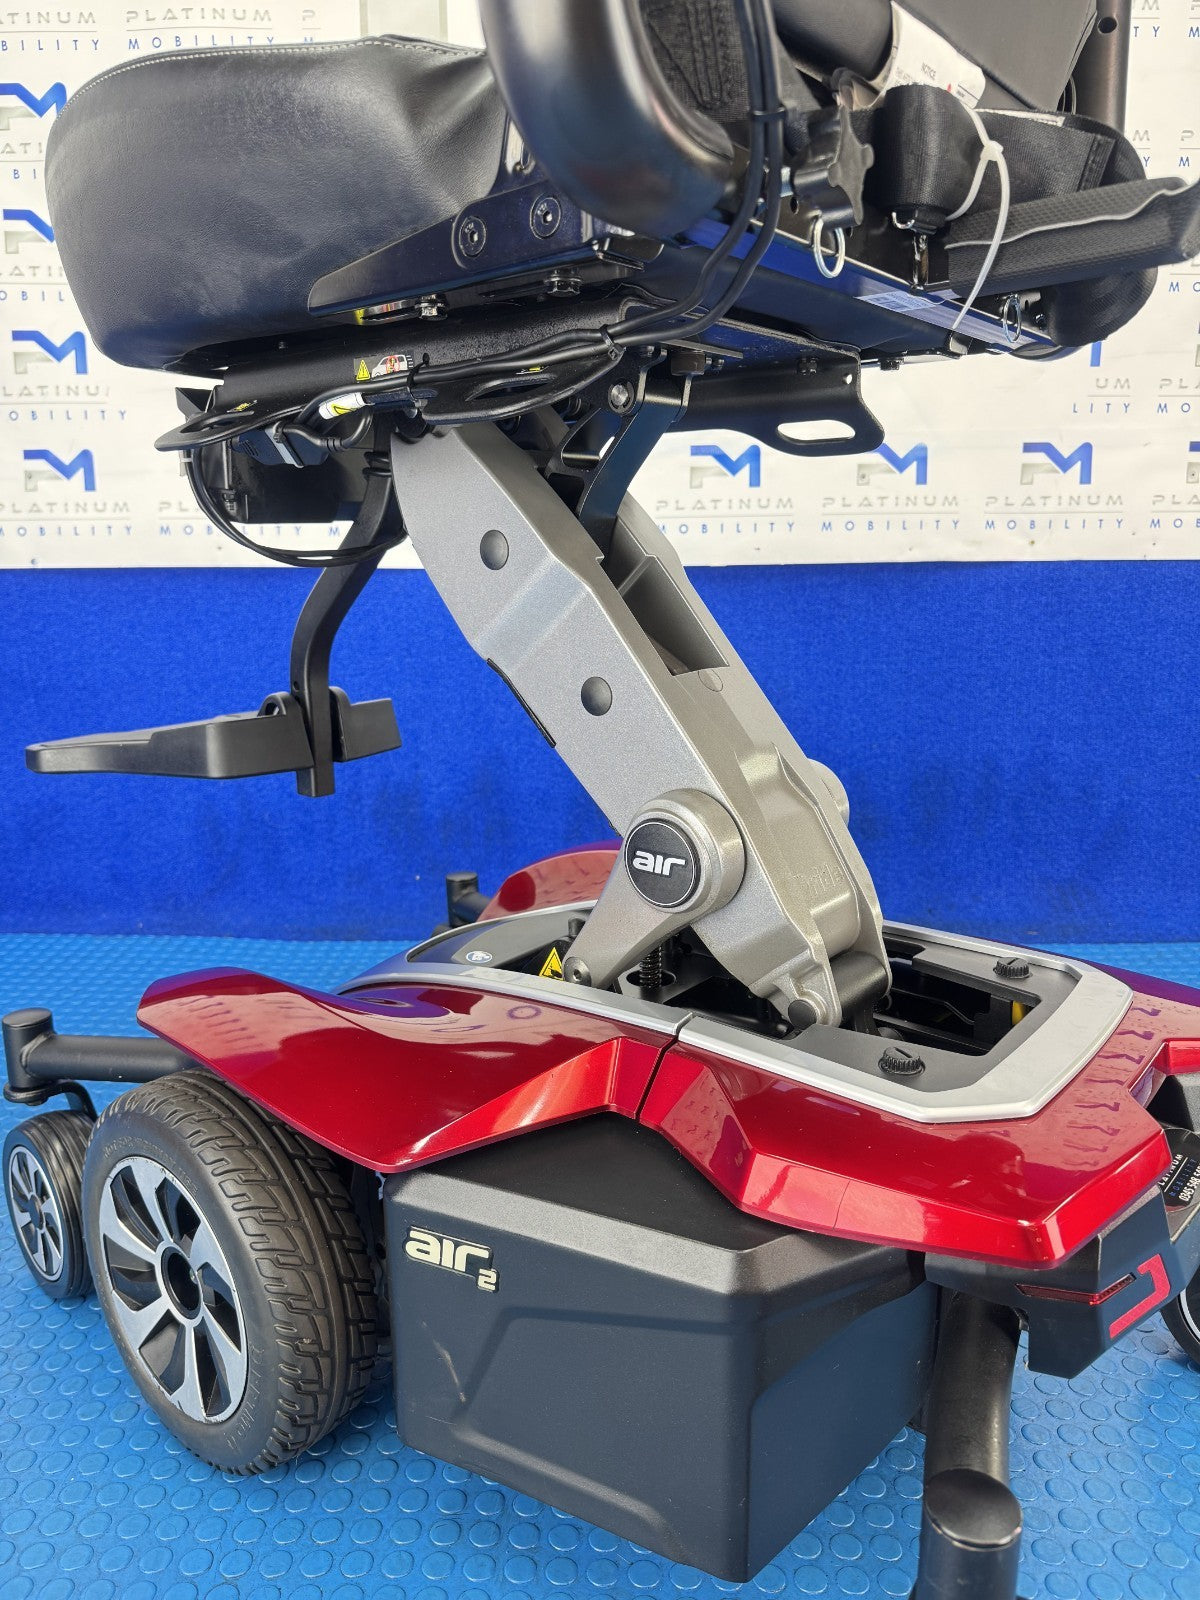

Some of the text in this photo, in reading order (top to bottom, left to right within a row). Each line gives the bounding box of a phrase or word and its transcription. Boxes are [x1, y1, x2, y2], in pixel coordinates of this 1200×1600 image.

[0, 11, 97, 24] TINUM
[125, 7, 273, 23] PLATINUM
[1, 39, 100, 52] BILITY
[128, 34, 275, 50] MOBILITY
[2, 384, 110, 398] LATINU
[8, 409, 127, 422] OBILITY
[656, 497, 794, 512] PLATINUM
[822, 495, 960, 509] PLATINUM
[984, 494, 1124, 508] PLATINUM
[159, 524, 303, 537] MOBLITY
[821, 519, 960, 532] MOBILITY
[984, 518, 1124, 531] MOBILITY
[632, 850, 686, 876] air
